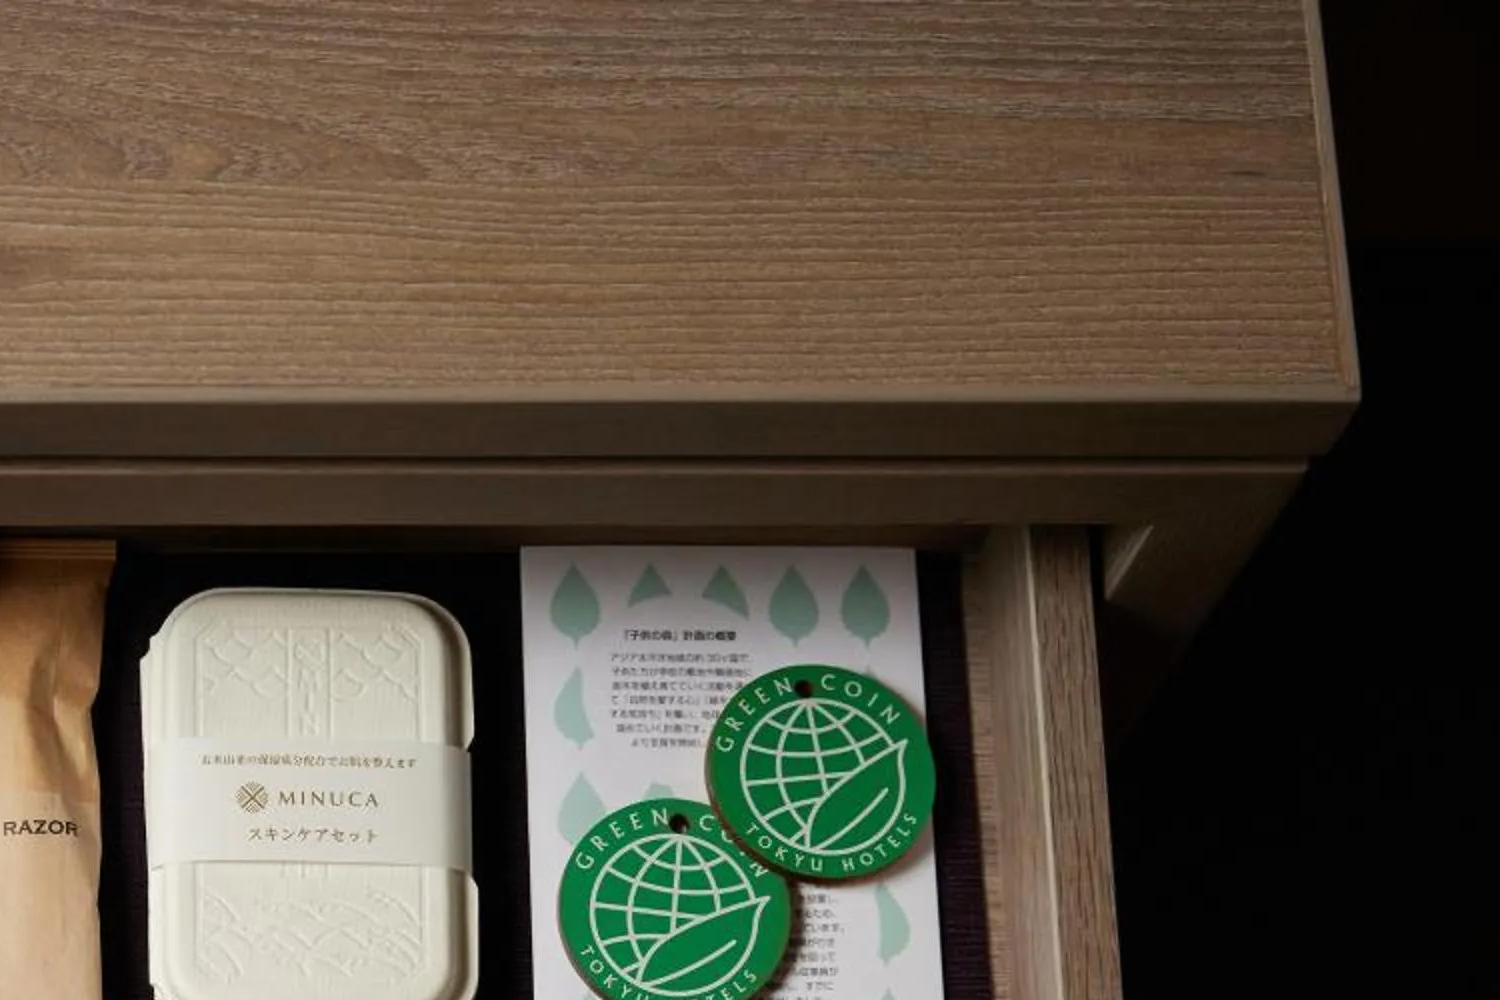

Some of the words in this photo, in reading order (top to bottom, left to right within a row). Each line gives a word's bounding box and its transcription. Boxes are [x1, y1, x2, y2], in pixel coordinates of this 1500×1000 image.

[715, 677, 793, 752] GREEN
[820, 672, 901, 725] COIN
[278, 790, 380, 808] MINUCA
[2, 819, 79, 837] RAZOR
[248, 827, 378, 843] スキンケアセット
[574, 807, 669, 870] GREEN
[699, 814, 770, 878] CN
[745, 821, 823, 872] TOKYU
[841, 812, 918, 872] HOTELS
